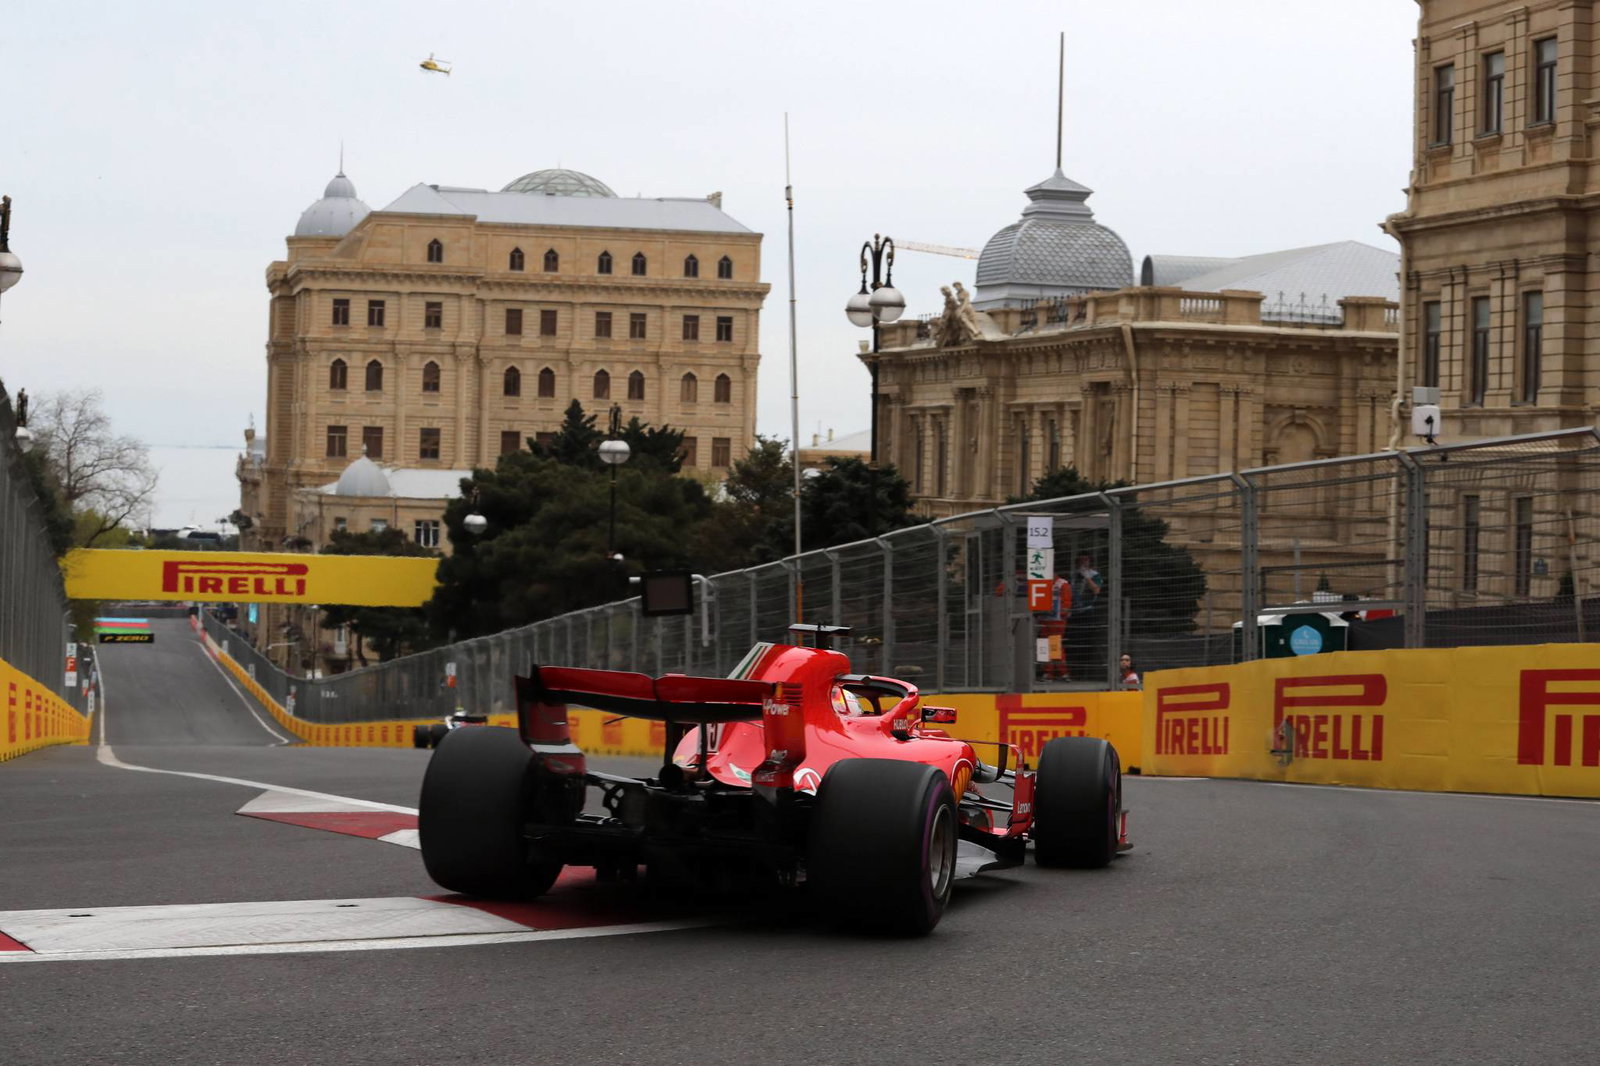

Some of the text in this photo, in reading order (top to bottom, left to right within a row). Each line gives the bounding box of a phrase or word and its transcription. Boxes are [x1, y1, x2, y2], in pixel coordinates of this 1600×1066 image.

[1029, 527, 1049, 537] 15.2
[162, 561, 309, 596] PIRELLI
[1031, 583, 1047, 607] F
[1155, 682, 1230, 755] PIRELLI
